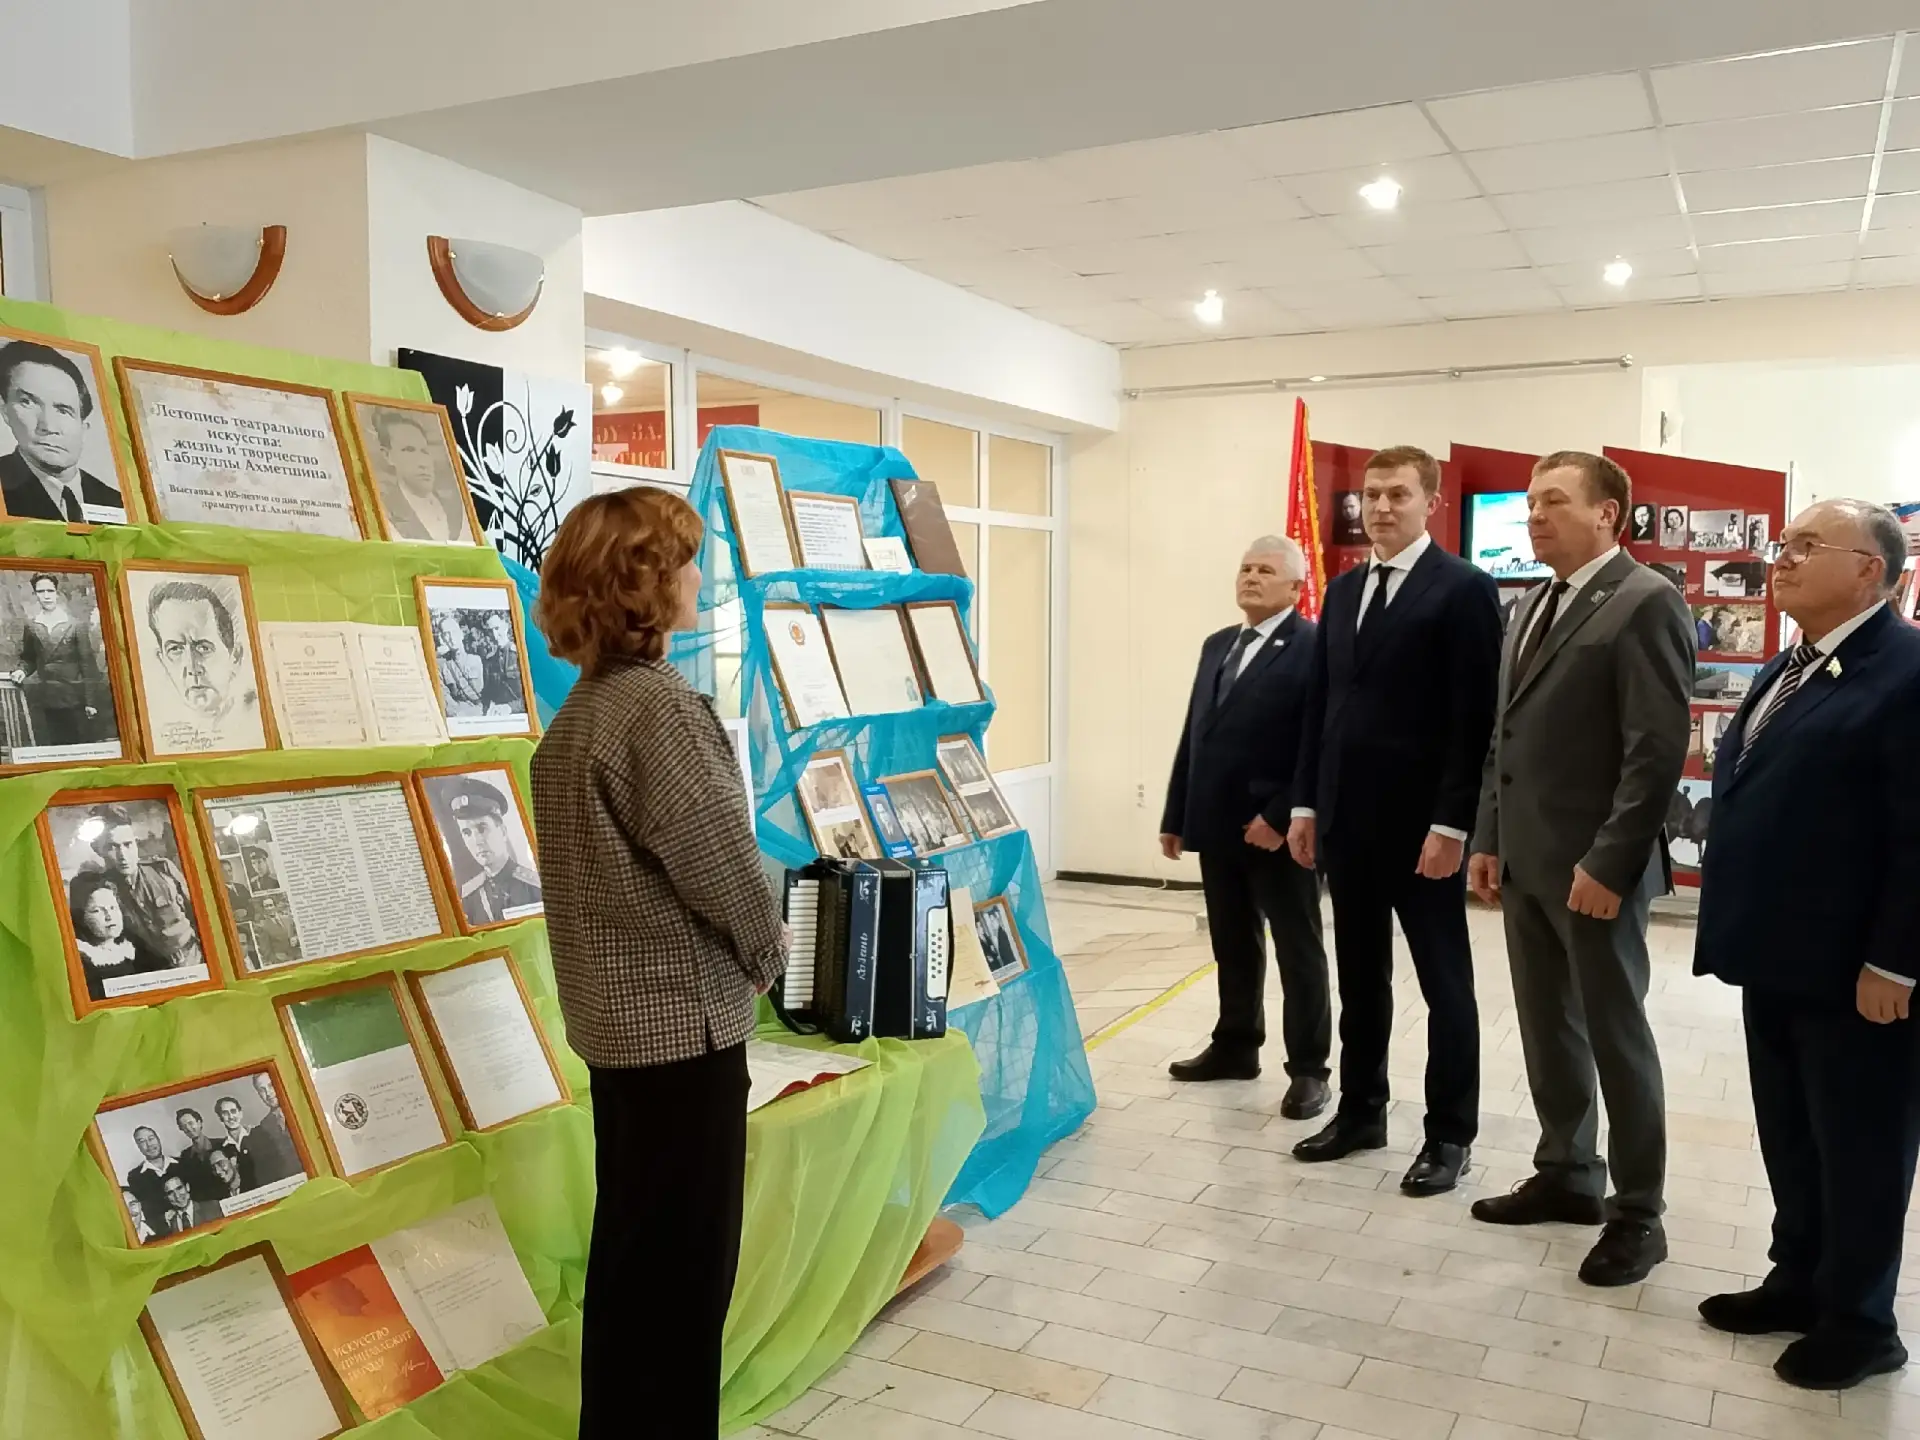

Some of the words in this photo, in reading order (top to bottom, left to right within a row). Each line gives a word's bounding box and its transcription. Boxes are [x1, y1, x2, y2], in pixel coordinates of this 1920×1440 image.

[207, 428, 282, 448] искусства:
[231, 416, 325, 439] театрального
[164, 449, 240, 470] Габдуллы
[173, 438, 223, 454] жизнь
[227, 445, 236, 456] и
[241, 447, 319, 466] творчество
[168, 484, 215, 497] Выставка
[224, 489, 269, 502] 105-летию
[280, 496, 298, 505] дня
[300, 497, 342, 509] рождения
[201, 499, 253, 514] драматурга
[333, 1327, 390, 1358] ИСКУССТВО
